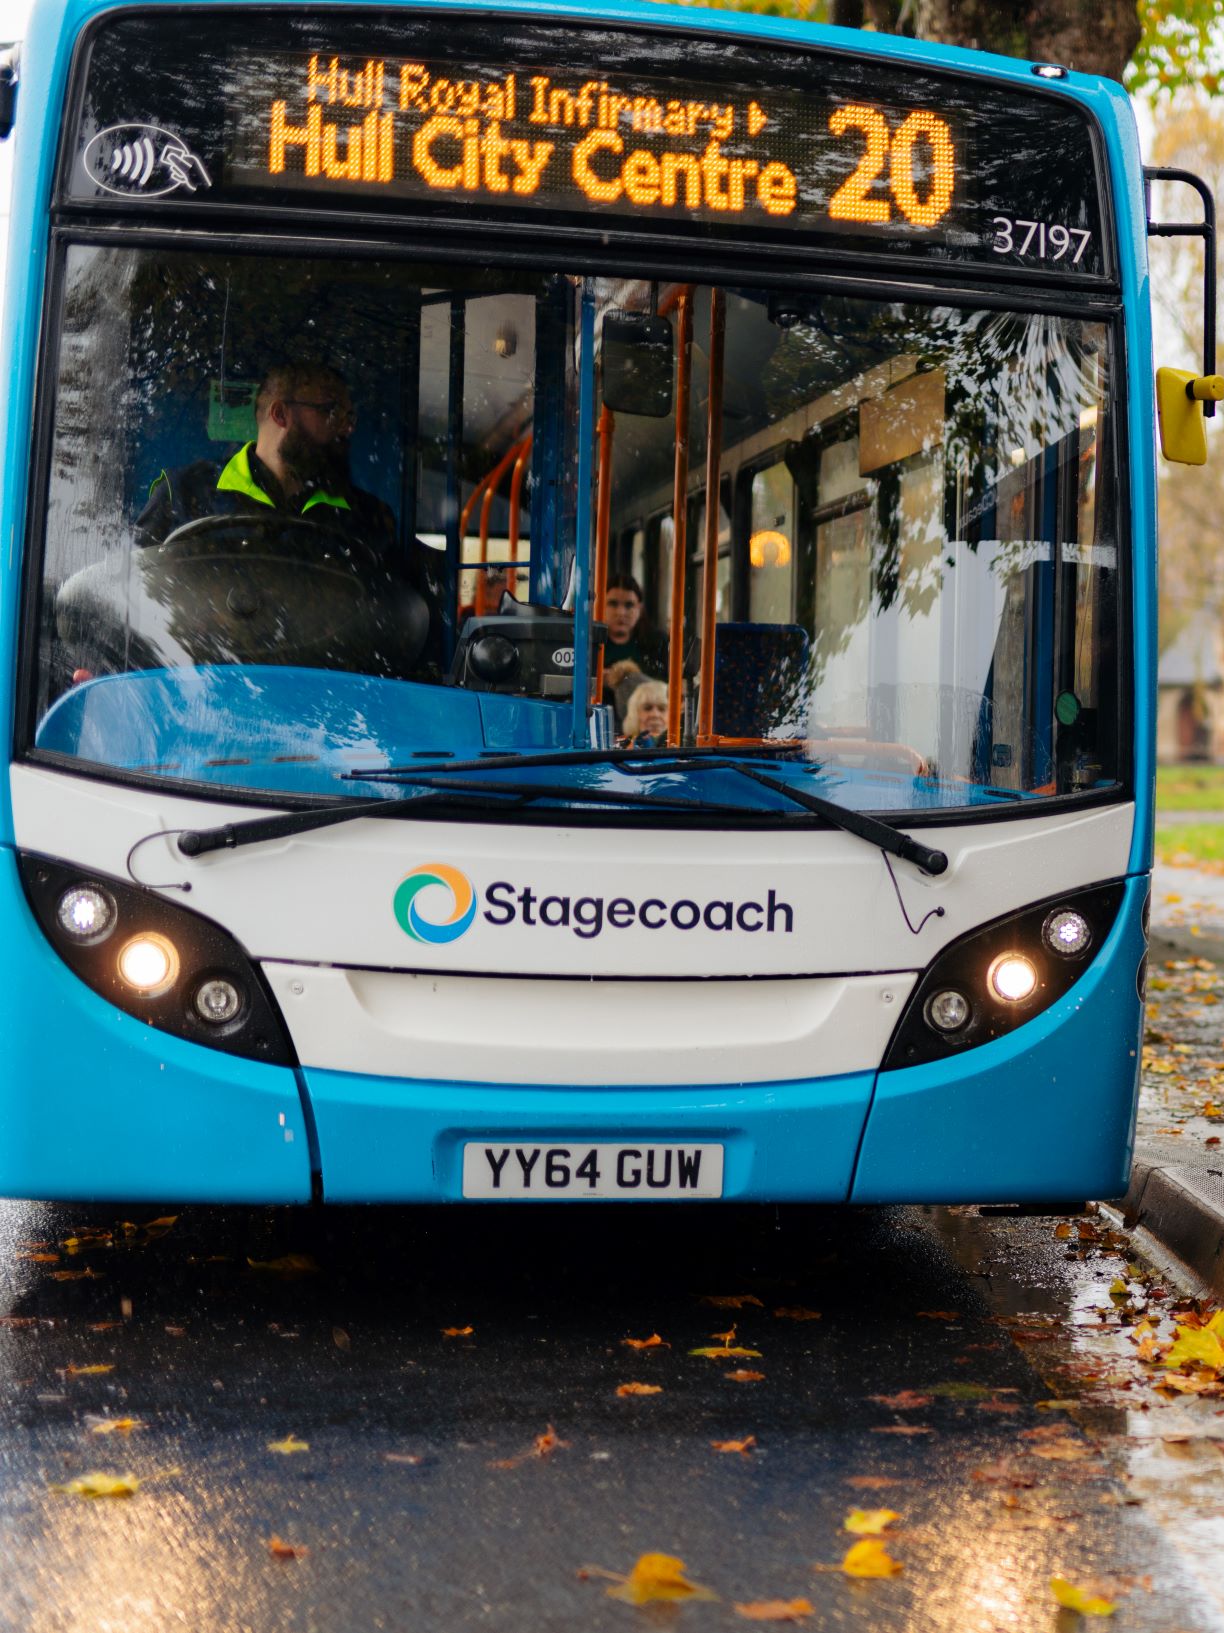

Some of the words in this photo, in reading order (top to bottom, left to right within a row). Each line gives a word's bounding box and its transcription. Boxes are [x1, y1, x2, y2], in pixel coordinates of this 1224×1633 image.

[308, 53, 385, 109] Hull
[400, 63, 516, 118] Royal
[529, 76, 734, 141] Infirmary
[269, 99, 395, 184] Hull
[413, 115, 555, 196] City
[572, 128, 797, 216] Centre
[829, 103, 955, 228] 20
[992, 216, 1092, 264] 37197
[483, 881, 794, 939] Stagecoach
[485, 1148, 601, 1189] YY64
[616, 1149, 702, 1189] GUW
